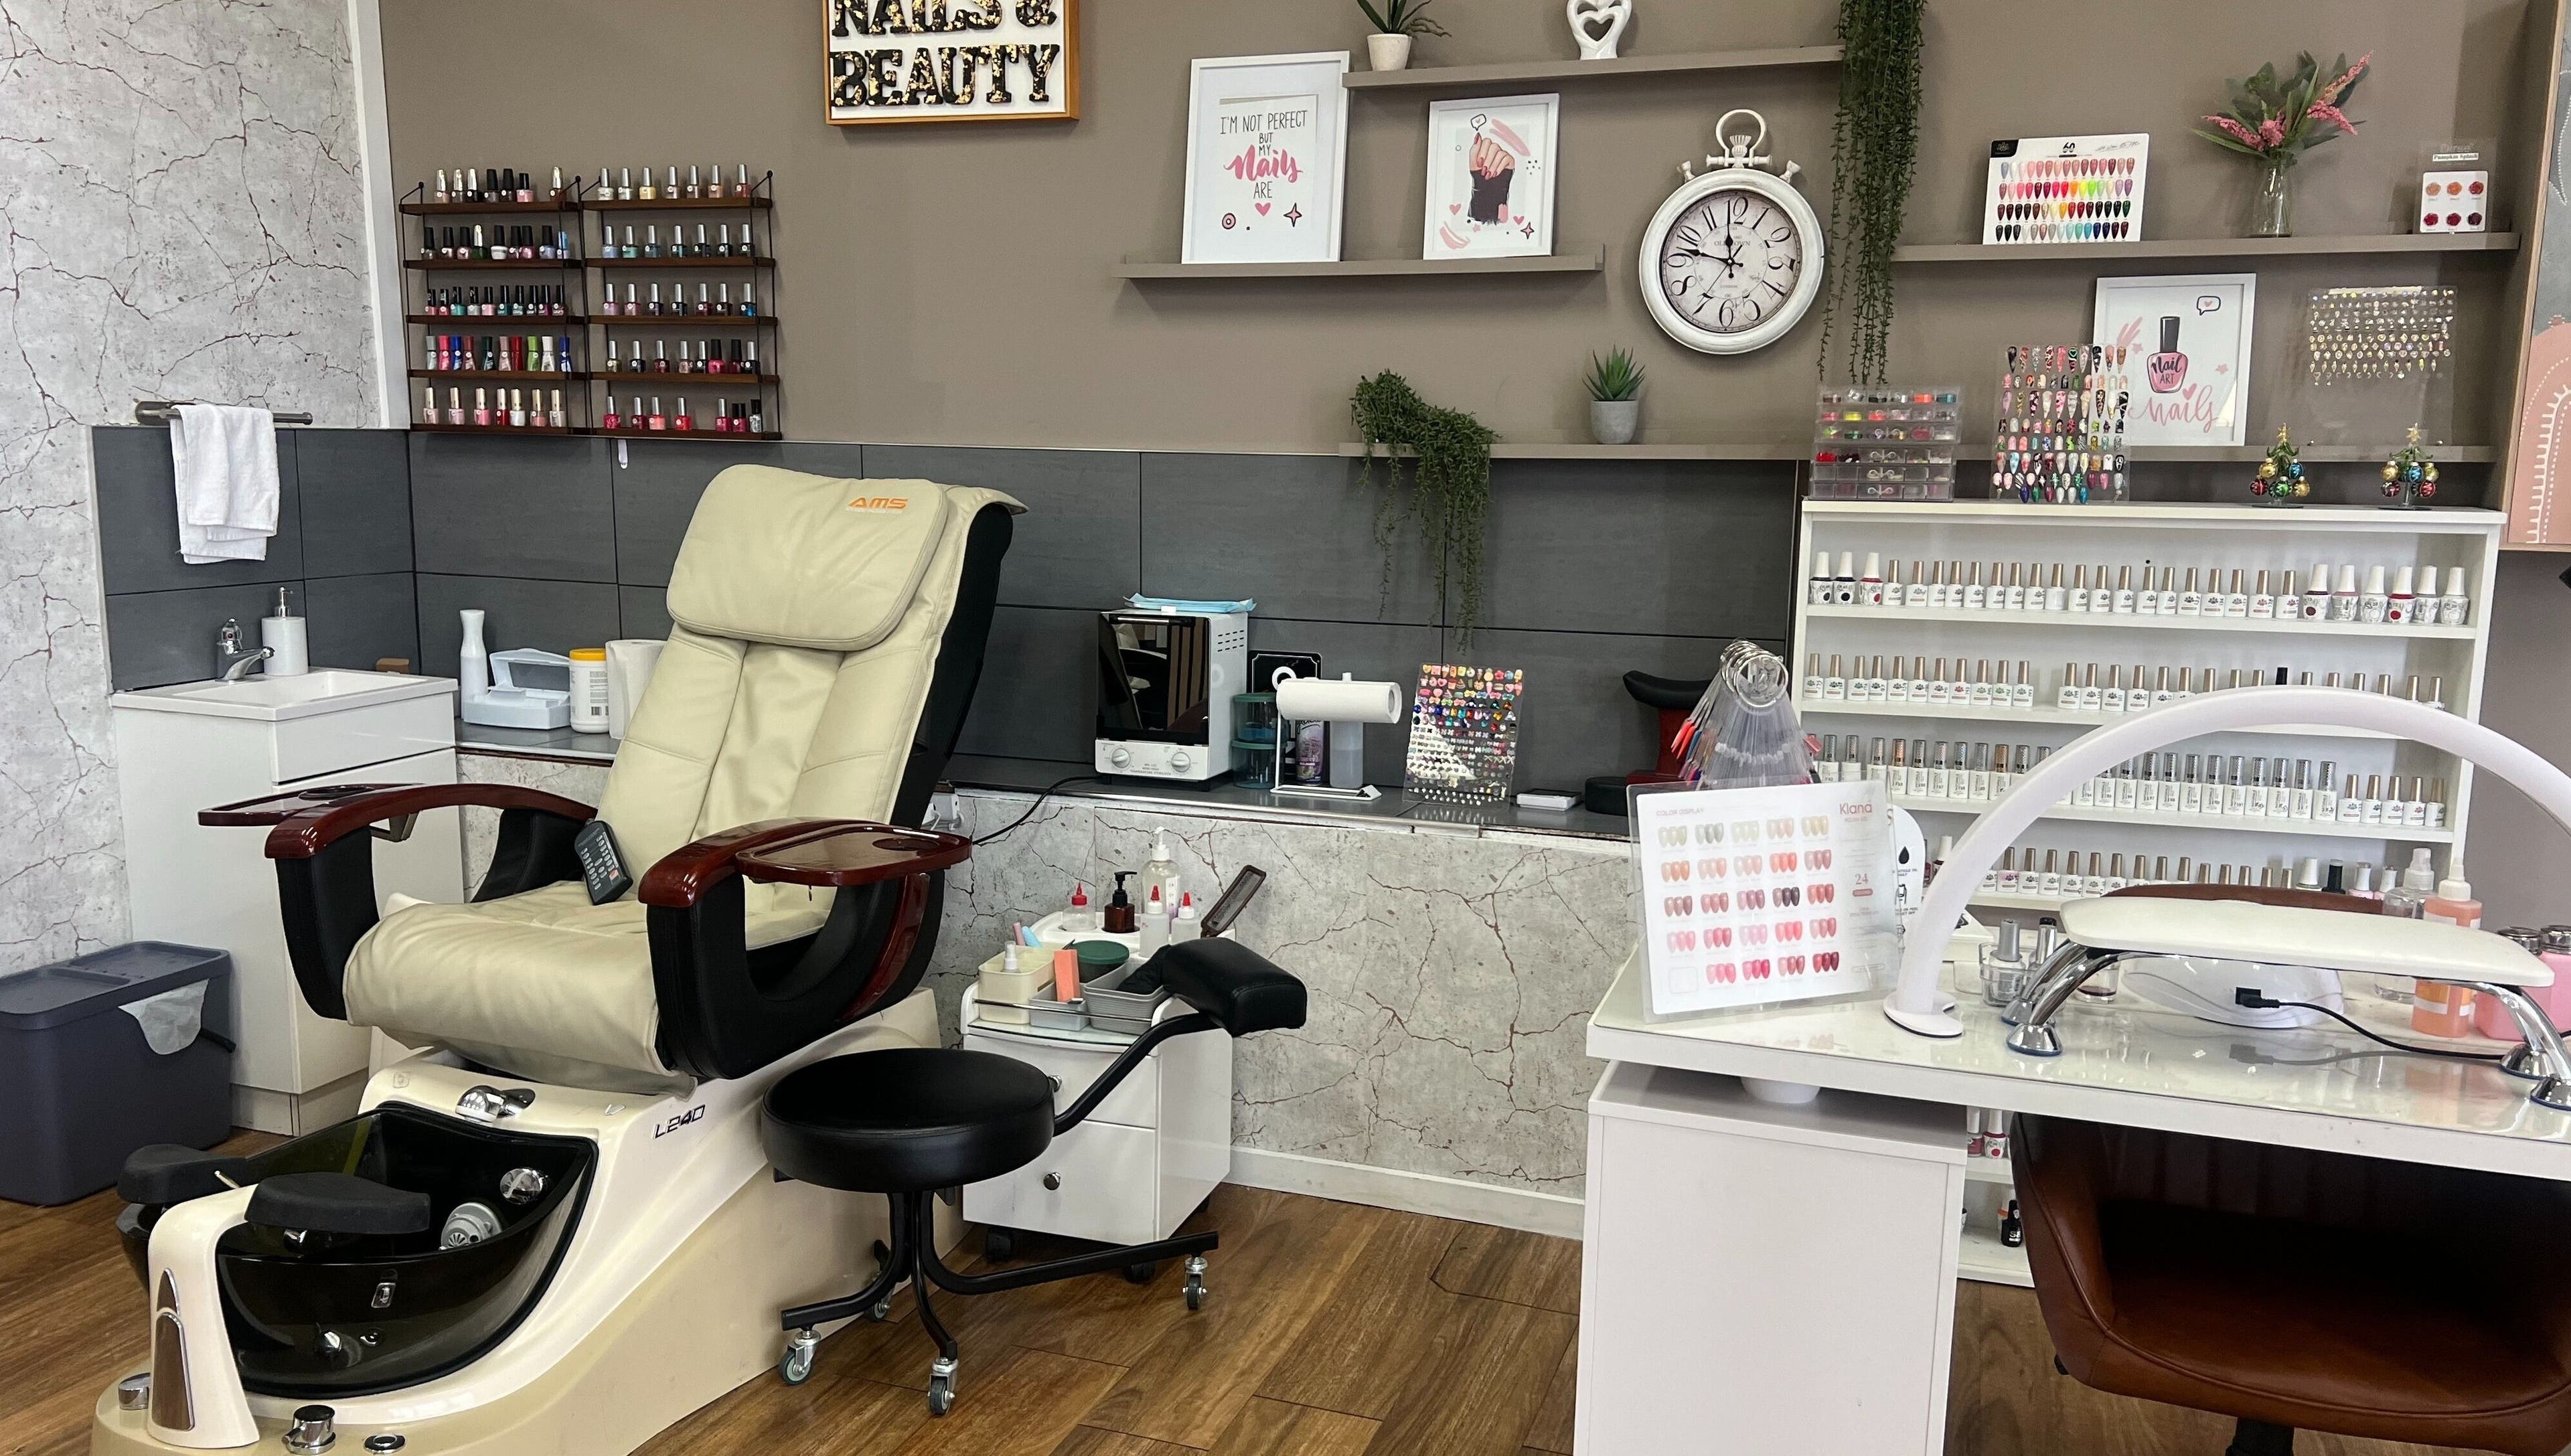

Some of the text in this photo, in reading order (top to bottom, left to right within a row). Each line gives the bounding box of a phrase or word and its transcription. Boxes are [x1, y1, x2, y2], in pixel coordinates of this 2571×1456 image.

[832, 0, 1003, 36] NAILS
[830, 44, 1060, 106] BEAUTY
[1220, 110, 1308, 134] I'M NOT PERFECT
[1259, 133, 1273, 144] BUT
[1258, 145, 1271, 156] MY
[1253, 181, 1273, 199] ARE
[1724, 196, 1749, 226] 12
[1751, 207, 1770, 230] 1
[1676, 225, 1702, 246] 10
[1764, 227, 1790, 248] 2
[1666, 252, 1694, 268] 9
[1768, 254, 1796, 272] 3
[1671, 274, 1696, 297] 8
[1762, 279, 1785, 301] 4
[1692, 293, 1714, 315] 7
[1719, 299, 1733, 328] 6
[1741, 294, 1761, 321] 5
[2159, 374, 2175, 384] ART
[848, 497, 909, 509] AMS
[1855, 873, 1869, 884] 24
[655, 1105, 705, 1139] L240
